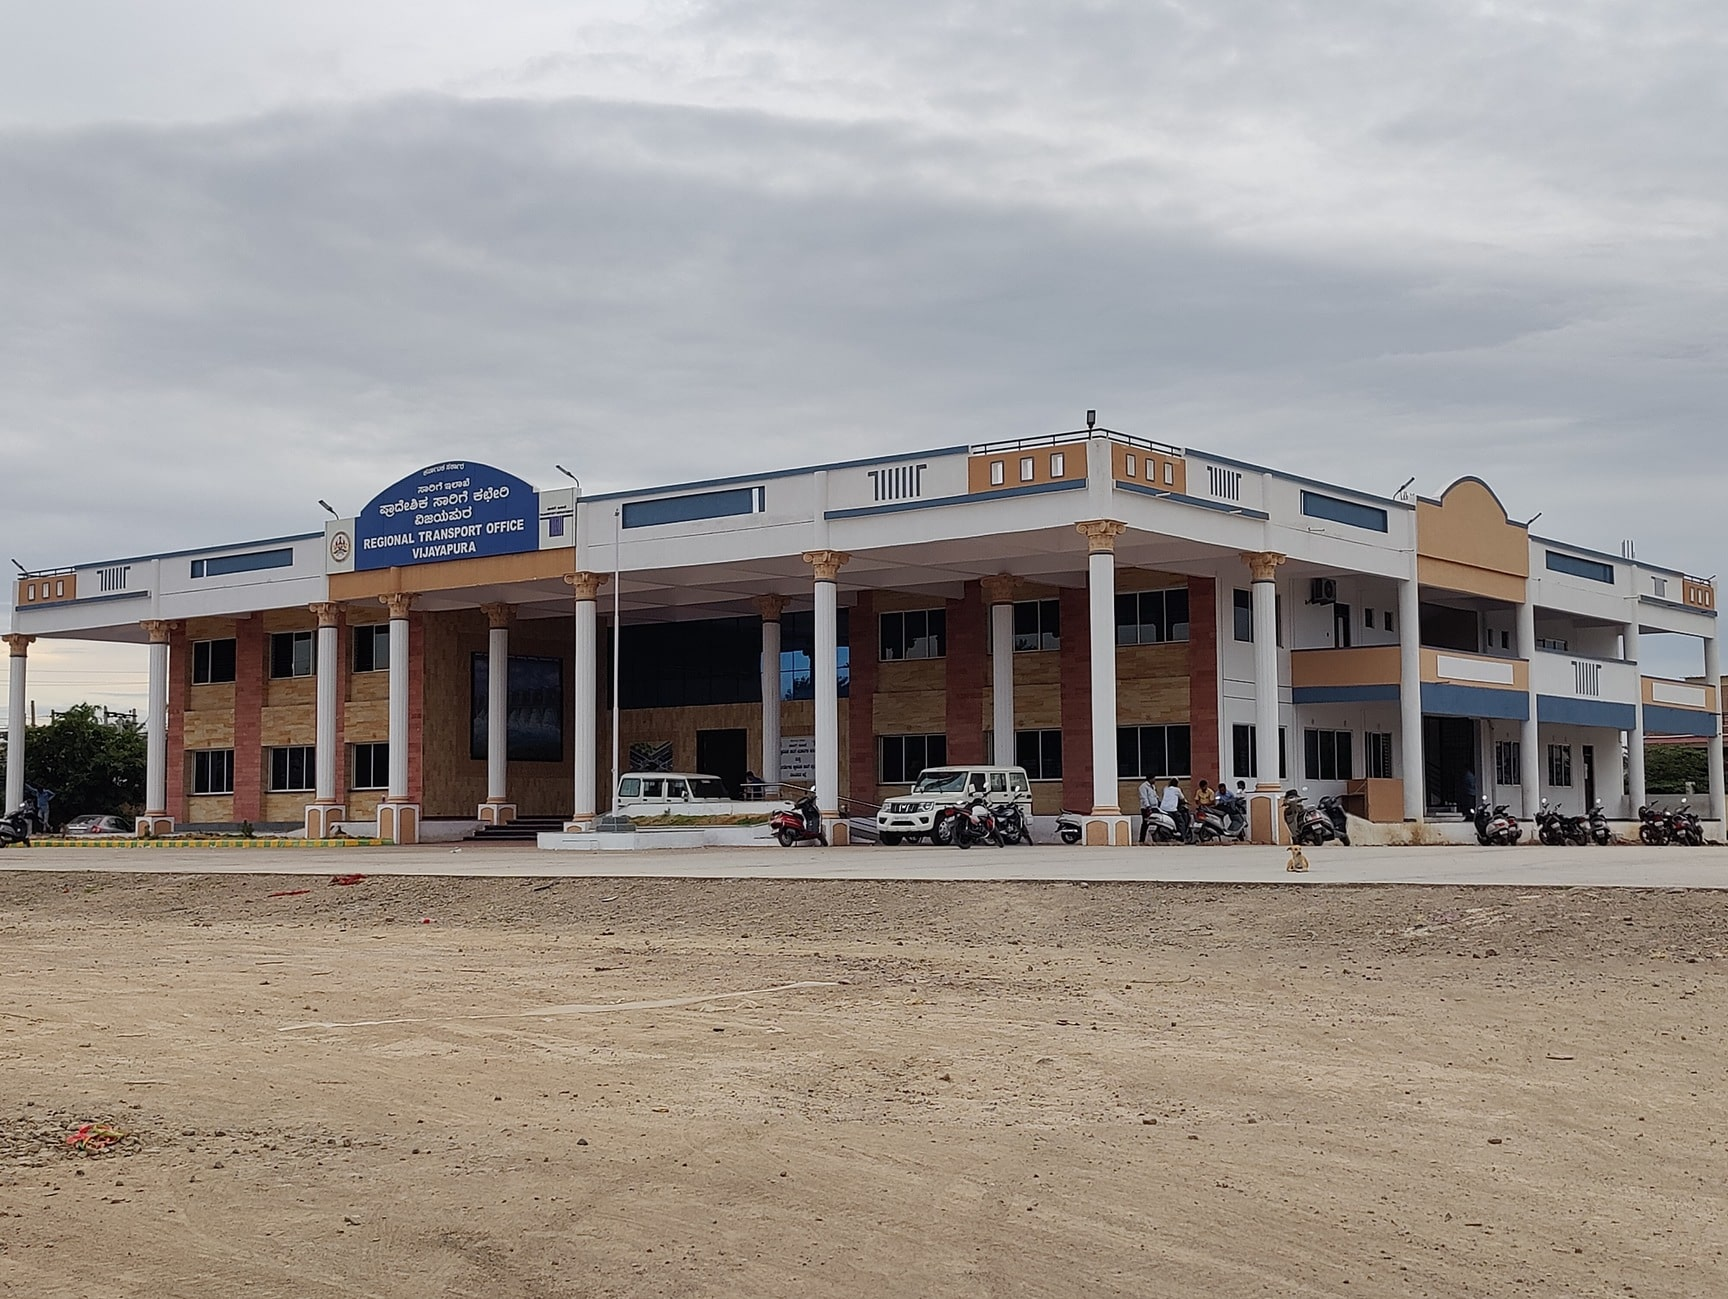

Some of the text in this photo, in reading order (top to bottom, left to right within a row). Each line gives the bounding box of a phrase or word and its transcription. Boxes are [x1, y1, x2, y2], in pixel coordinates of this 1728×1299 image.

[417, 481, 443, 494] ಸಾರಿಗೆ
[379, 496, 429, 517] ಪ್ರಾದೇಶಿಕ
[433, 490, 469, 507] ಸಾರಿಗೆ
[414, 506, 473, 525] ವಿಜಯಪುರ
[363, 518, 524, 550] REGIONAL TRANSPORT OFFICE
[412, 541, 476, 559] VIJAYAPURA
